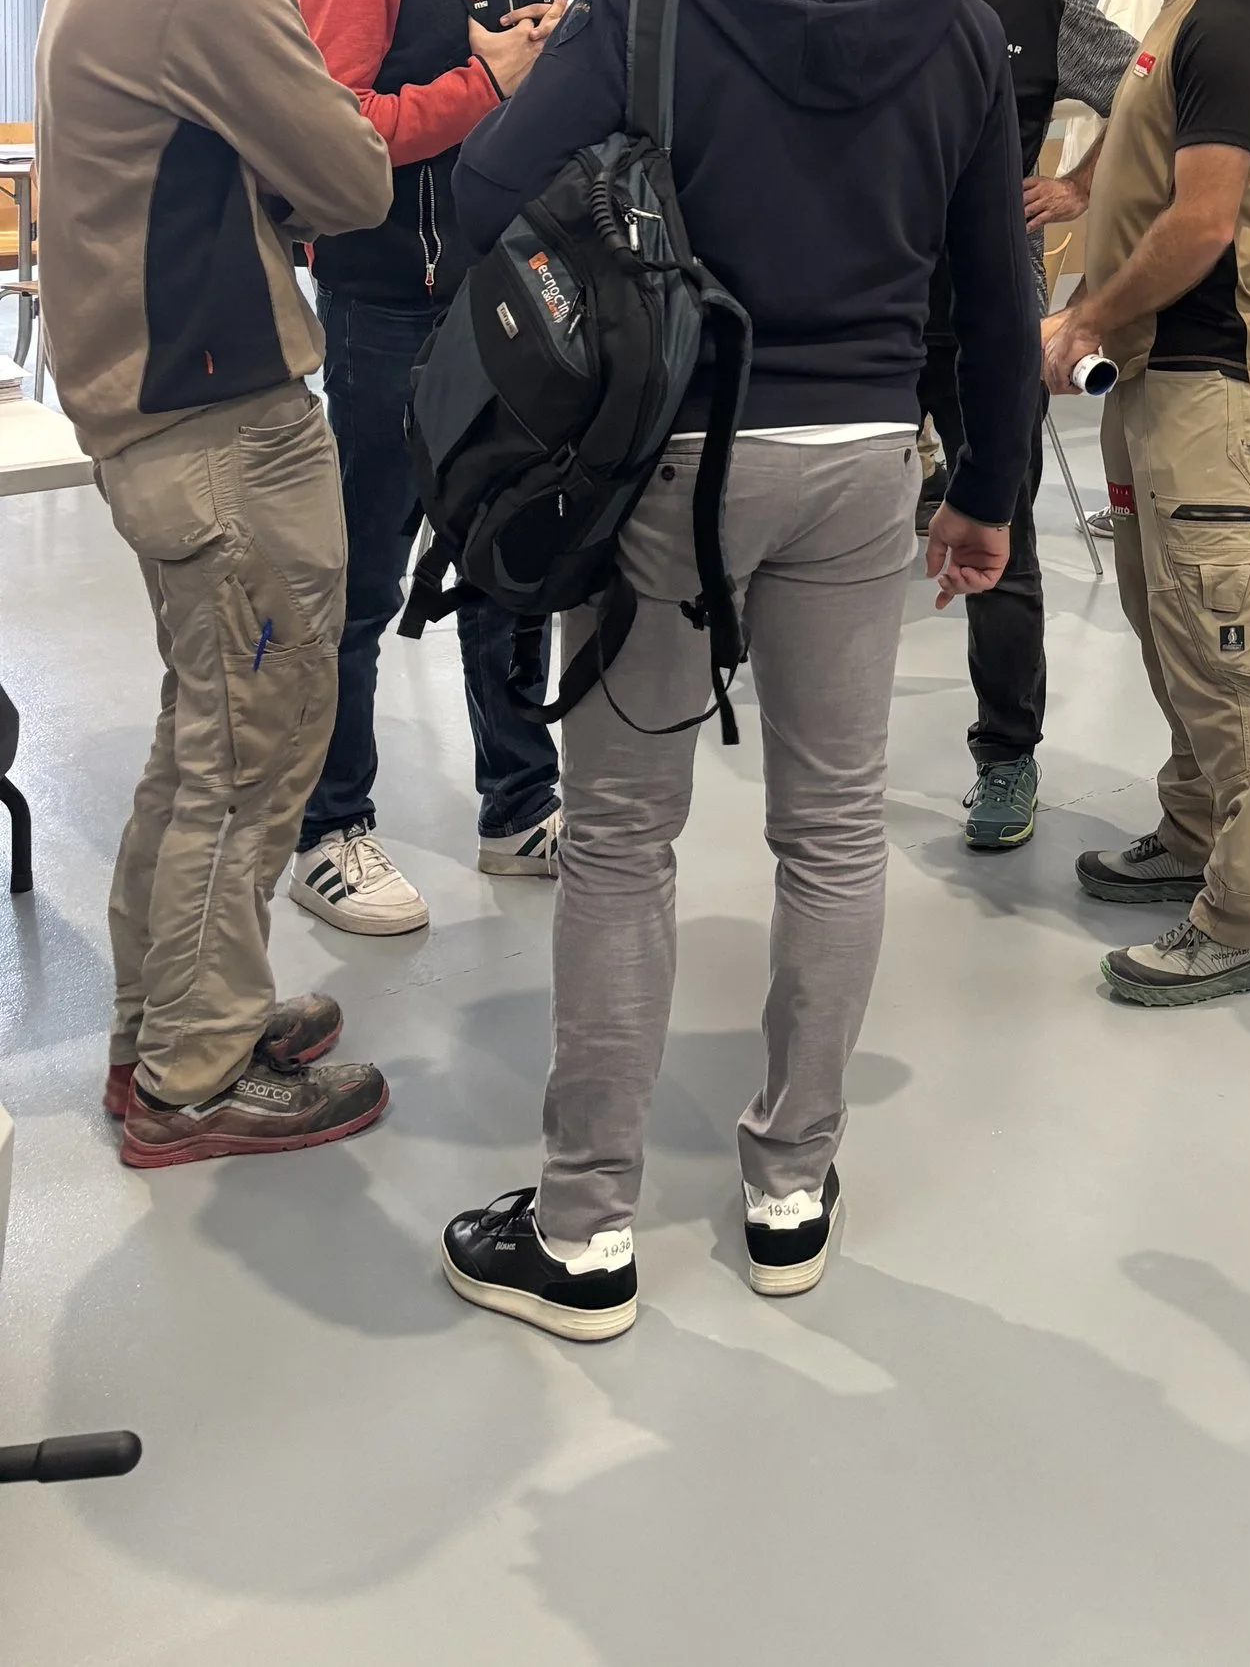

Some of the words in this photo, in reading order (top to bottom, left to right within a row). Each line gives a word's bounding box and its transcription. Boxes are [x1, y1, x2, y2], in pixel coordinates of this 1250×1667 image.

[236, 1079, 292, 1102] sparco
[767, 1202, 800, 1217] 1936
[602, 1237, 631, 1258] 1936
